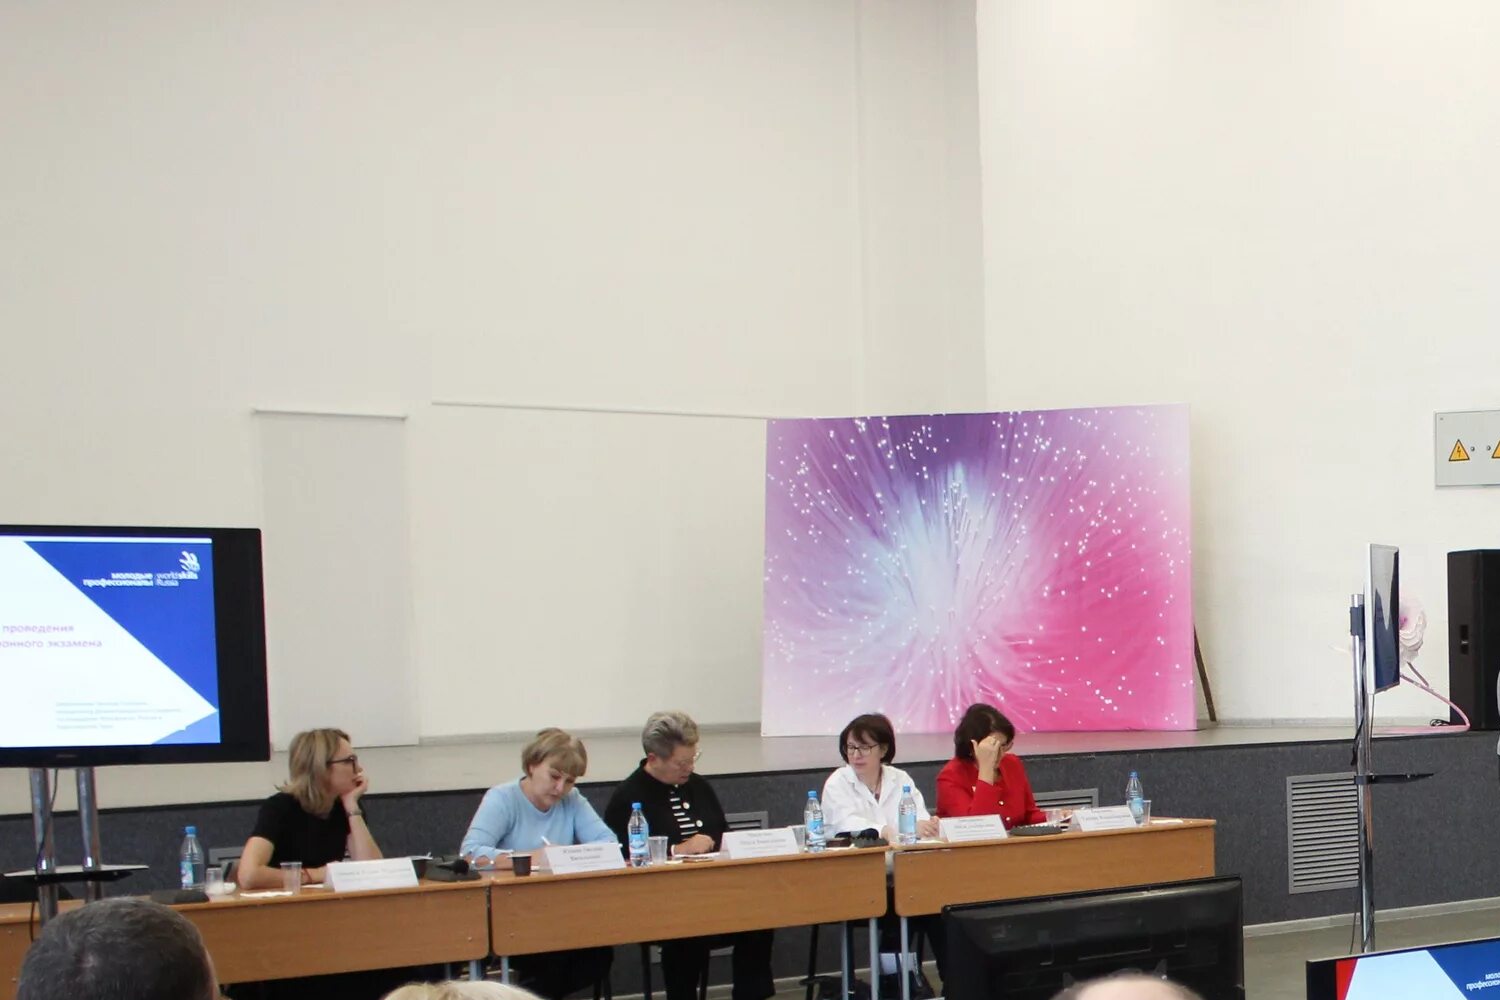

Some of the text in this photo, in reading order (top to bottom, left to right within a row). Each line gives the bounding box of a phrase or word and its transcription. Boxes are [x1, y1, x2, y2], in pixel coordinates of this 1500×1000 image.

[2, 625, 75, 634] проведения
[0, 640, 103, 648] онного экзамена
